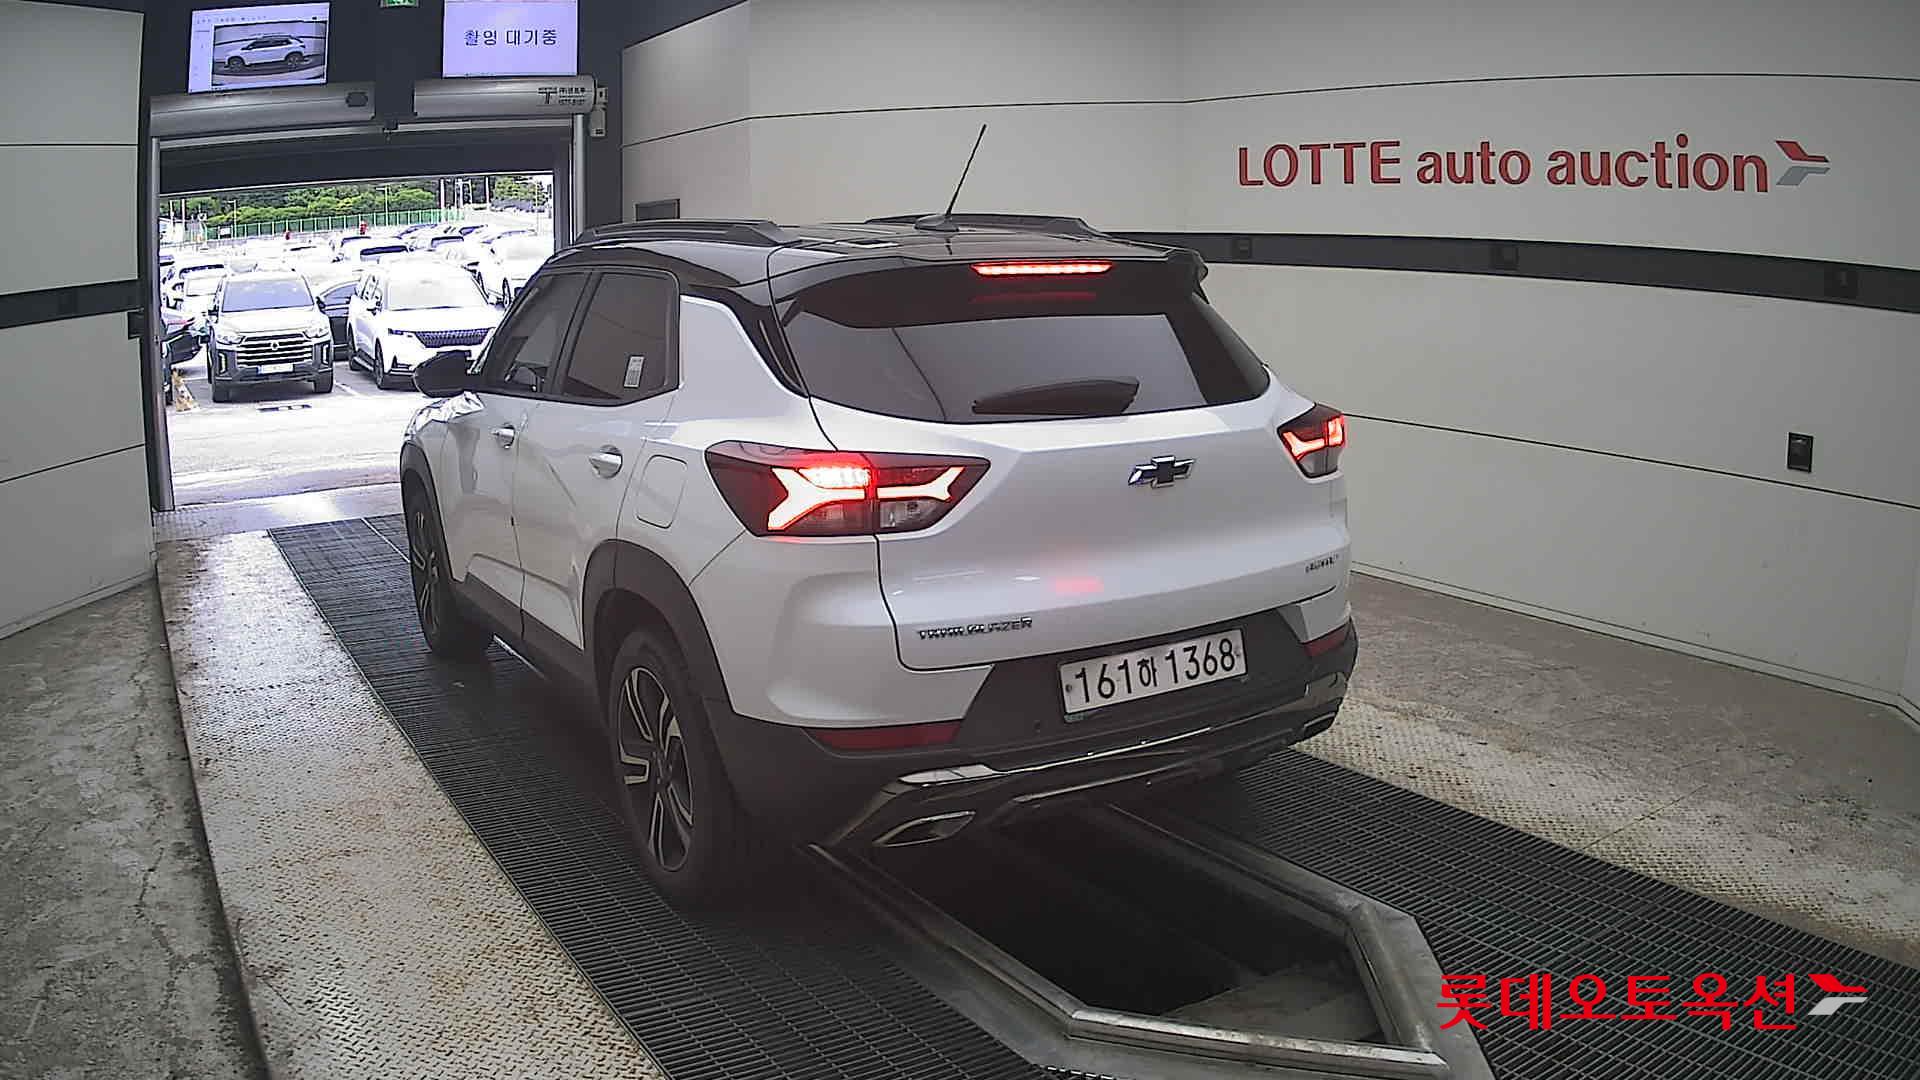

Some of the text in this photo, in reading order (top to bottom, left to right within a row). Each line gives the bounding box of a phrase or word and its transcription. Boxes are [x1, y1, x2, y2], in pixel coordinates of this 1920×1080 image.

[506, 29, 557, 46] 대기중
[1239, 133, 1769, 192] LOTTE auto auction
[1074, 637, 1236, 704] 161하 1368
